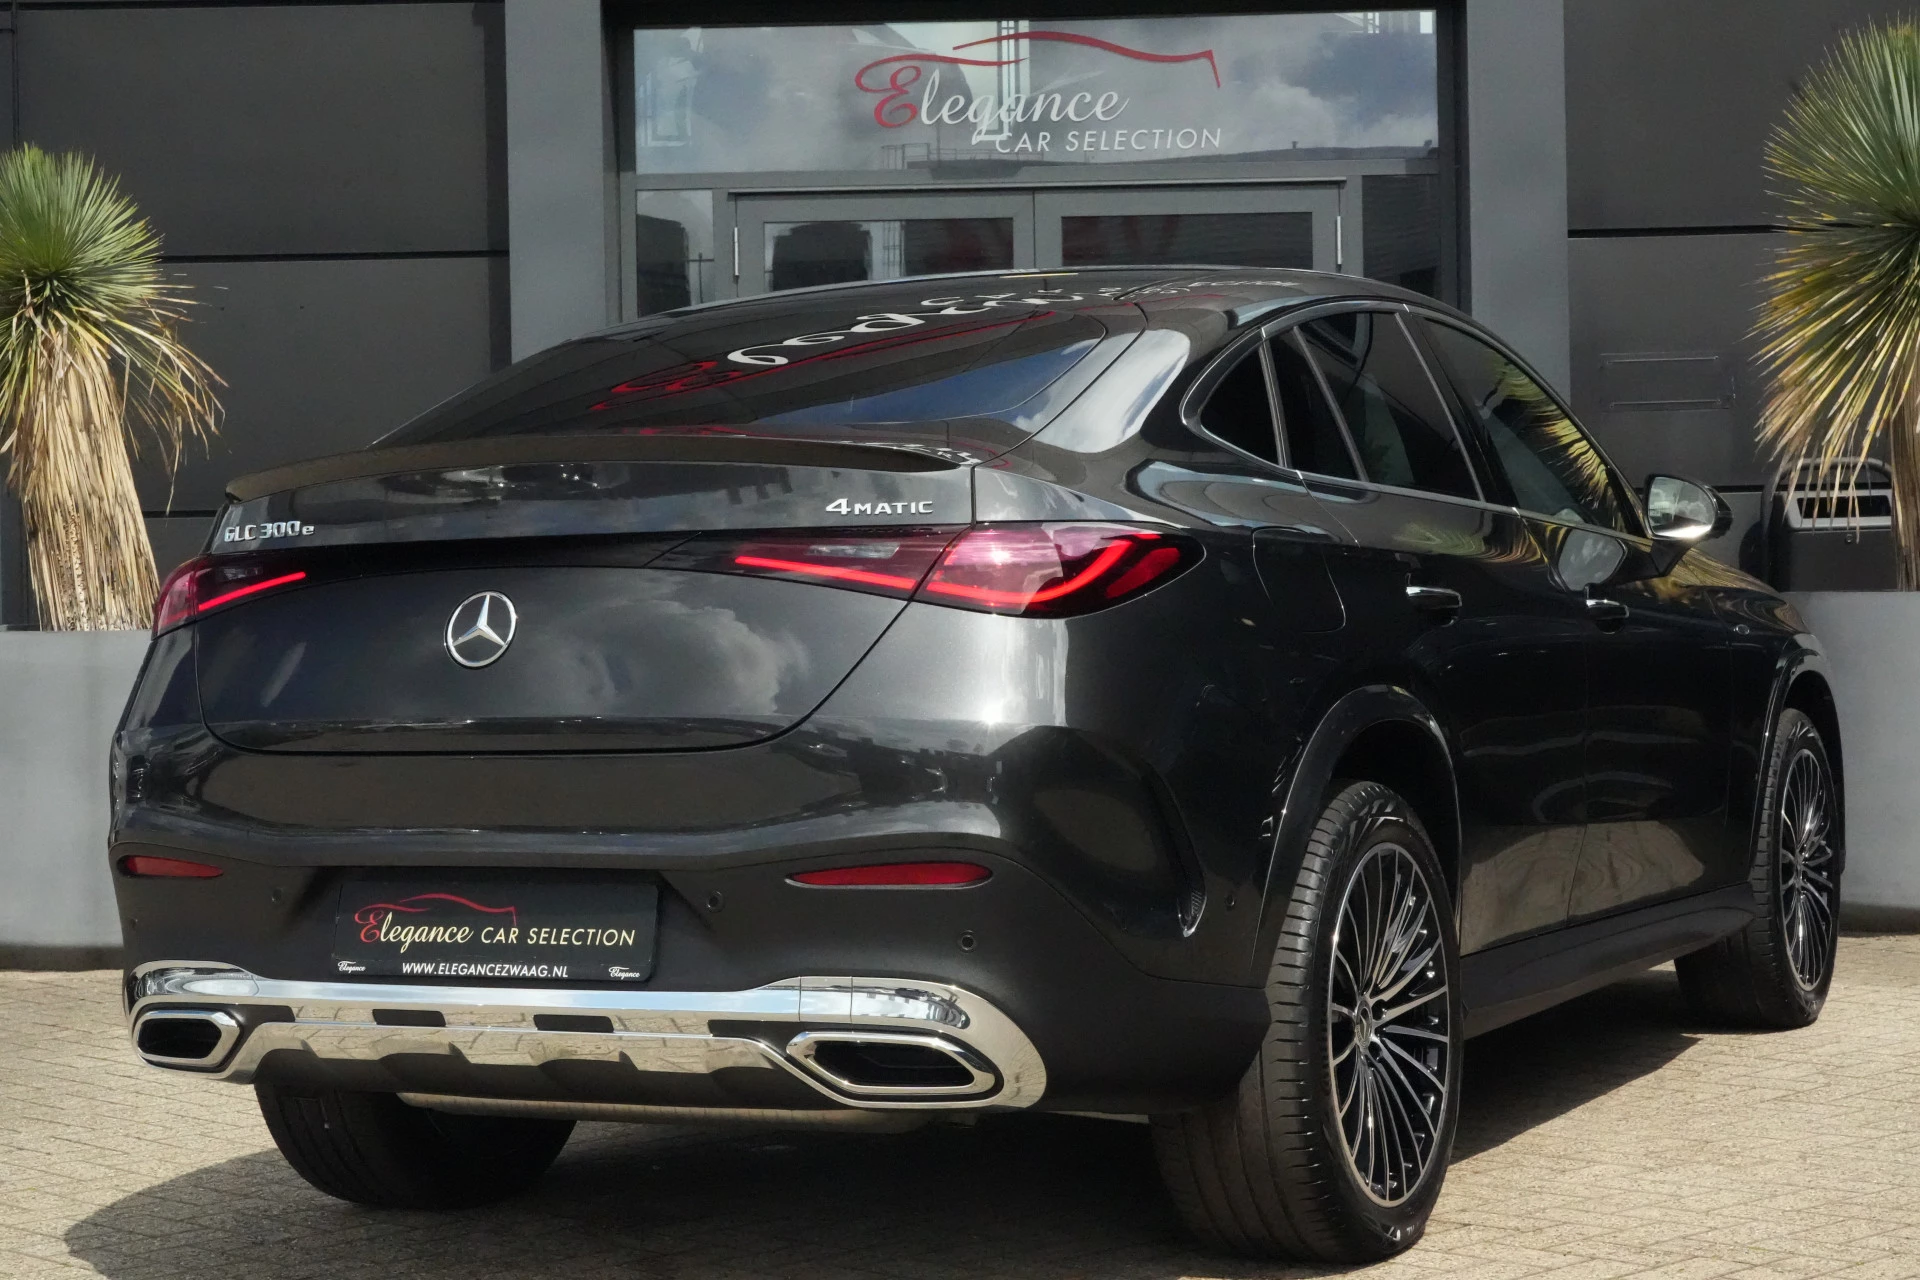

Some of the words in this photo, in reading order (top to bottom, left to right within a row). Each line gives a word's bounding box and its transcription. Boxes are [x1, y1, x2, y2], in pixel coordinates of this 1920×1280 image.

[855, 54, 1129, 146] Elegance
[995, 131, 1051, 154] CAR
[1065, 127, 1221, 152] SELECTION
[825, 498, 934, 515] 4MATIC
[224, 525, 256, 542] GLC
[354, 903, 474, 953] Elegance
[481, 927, 518, 946] CAR
[527, 928, 636, 947] SELECTION
[338, 960, 366, 973] Elegance
[402, 962, 569, 978] WWW.ELEGANCEZWAAG.NL
[608, 966, 640, 980] Elegance
